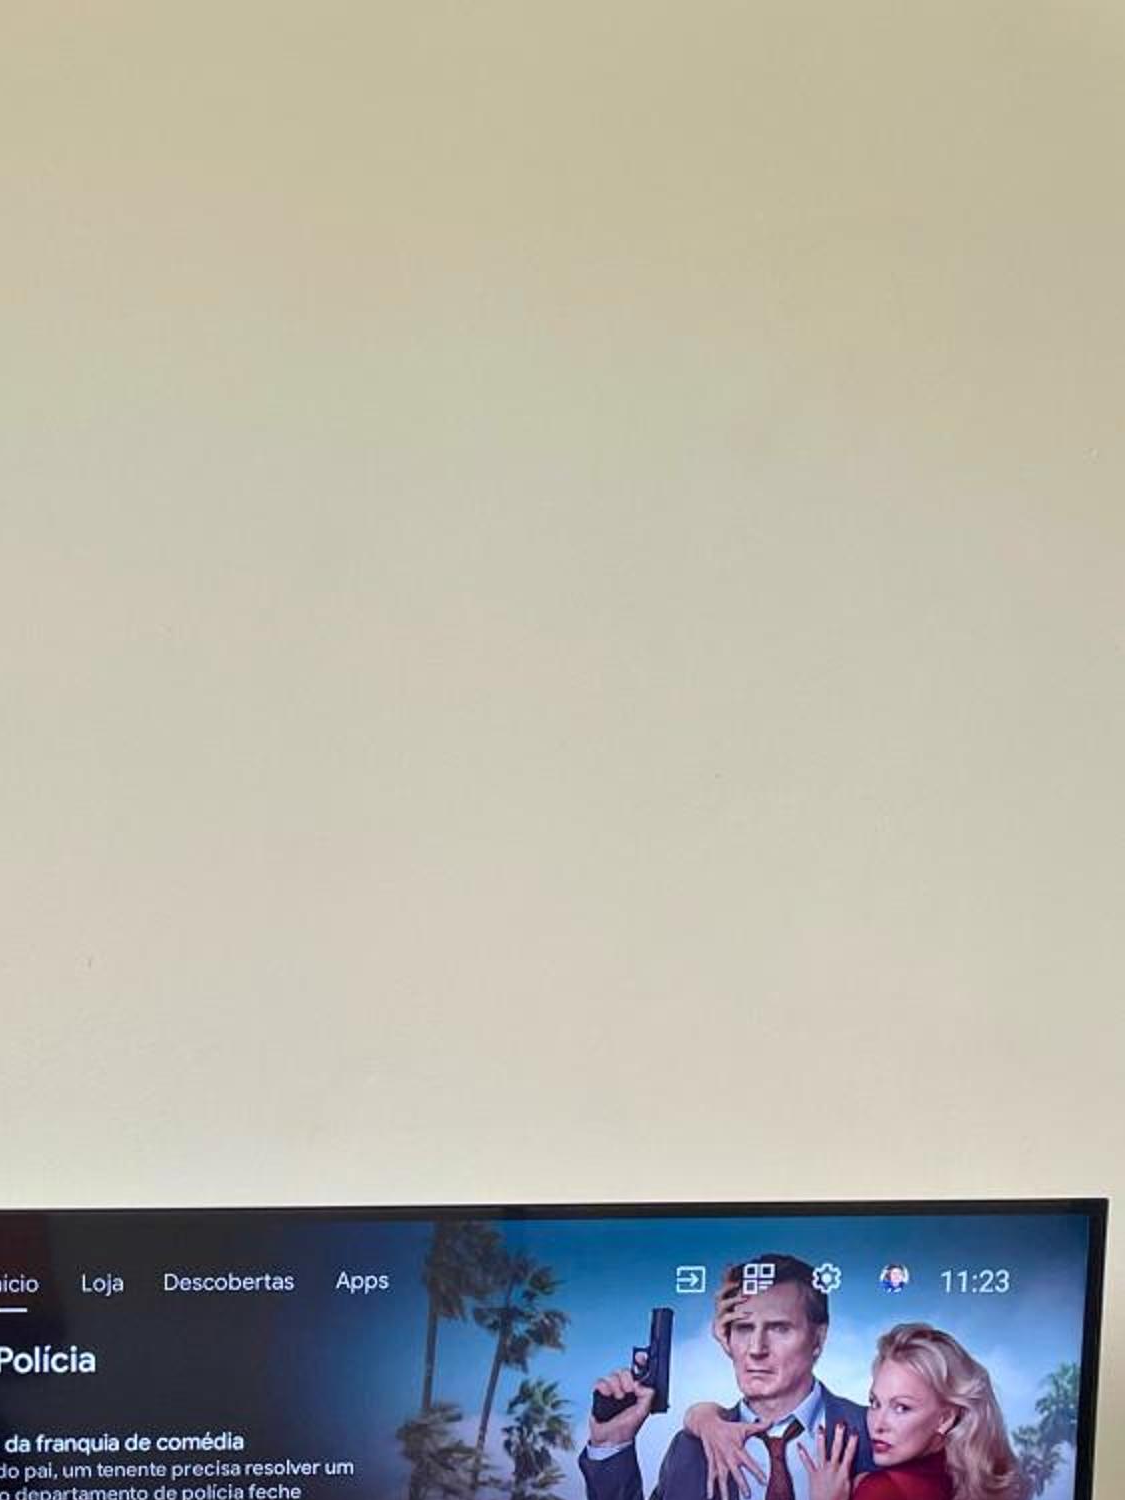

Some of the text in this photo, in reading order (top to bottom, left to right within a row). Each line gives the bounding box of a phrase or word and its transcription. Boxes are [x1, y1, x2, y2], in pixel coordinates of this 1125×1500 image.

[82, 1273, 124, 1296] Loja
[163, 1272, 295, 1291] Descobertas
[336, 1271, 390, 1294] Apps
[940, 1269, 1010, 1293] 11:23
[4, 1434, 31, 1453] da
[35, 1433, 120, 1456] franquia
[125, 1432, 151, 1451] de
[156, 1431, 244, 1450] comédia
[24, 1462, 58, 1482] pai,
[62, 1464, 92, 1478] um
[96, 1462, 167, 1477] tenente
[172, 1460, 241, 1480] precisa
[245, 1459, 320, 1476] resolver
[325, 1461, 355, 1475] um
[153, 1485, 178, 1500] de
[248, 1483, 302, 1499] feche
